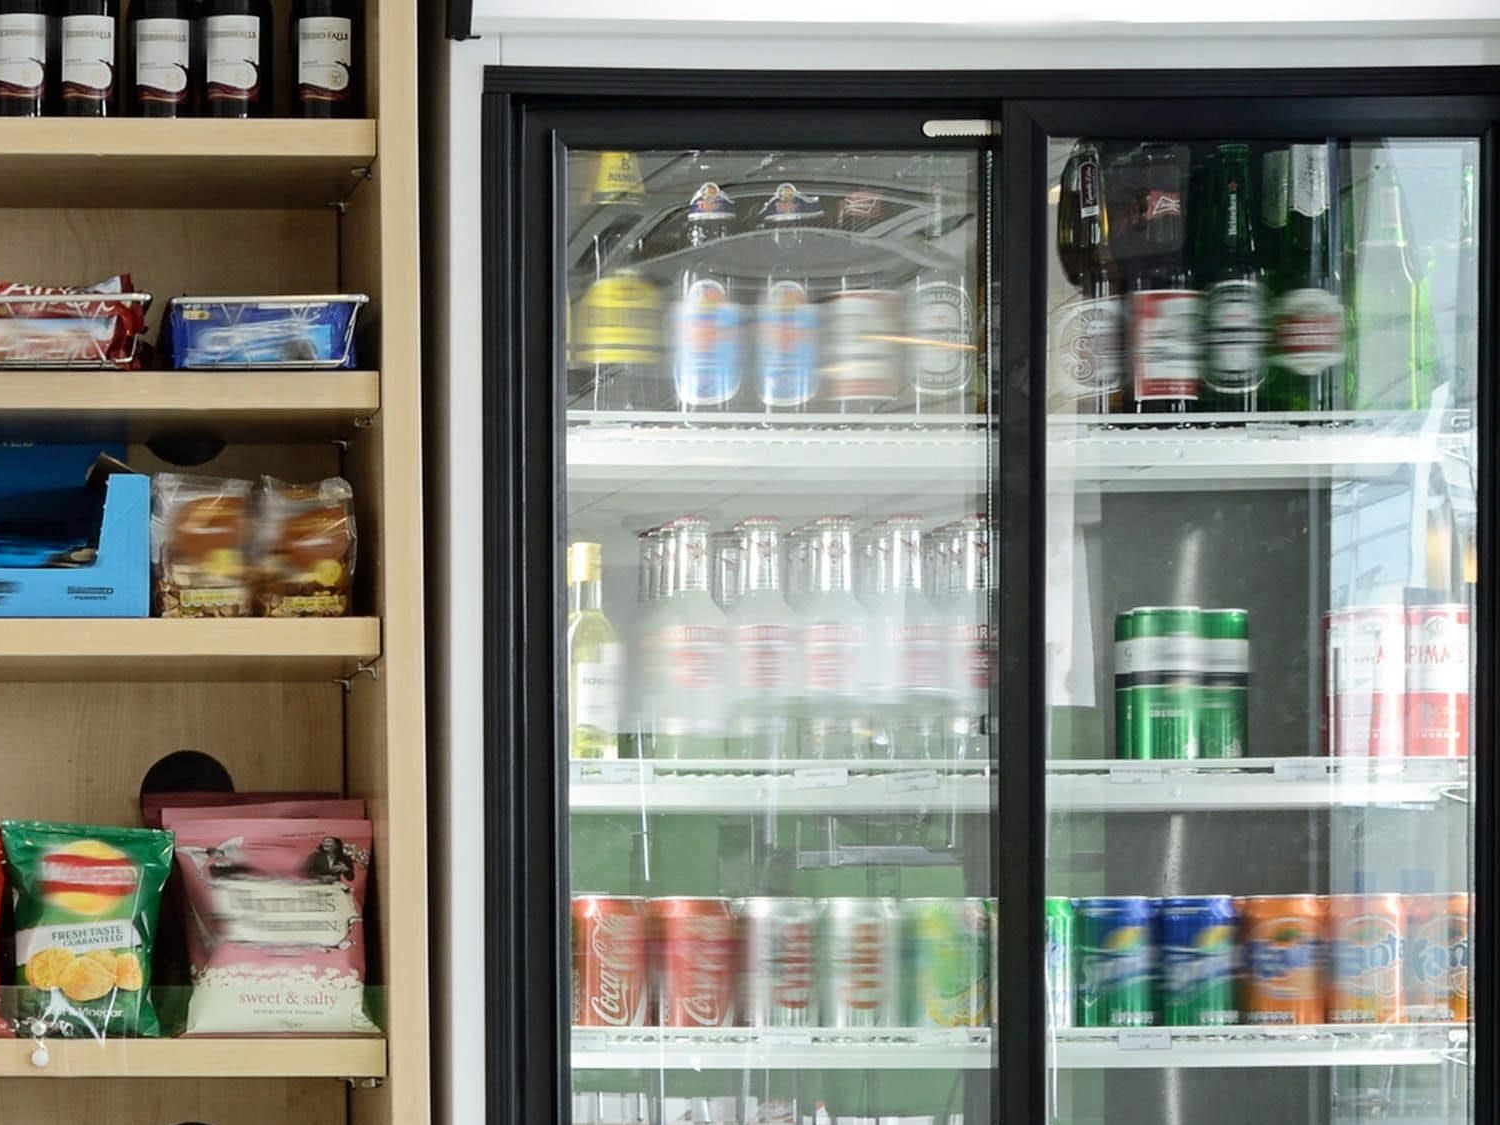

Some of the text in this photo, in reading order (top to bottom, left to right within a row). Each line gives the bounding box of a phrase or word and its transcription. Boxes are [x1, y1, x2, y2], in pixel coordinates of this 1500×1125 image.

[51, 925, 124, 941] FRESH TASTE
[238, 991, 337, 1009] sweet & salty
